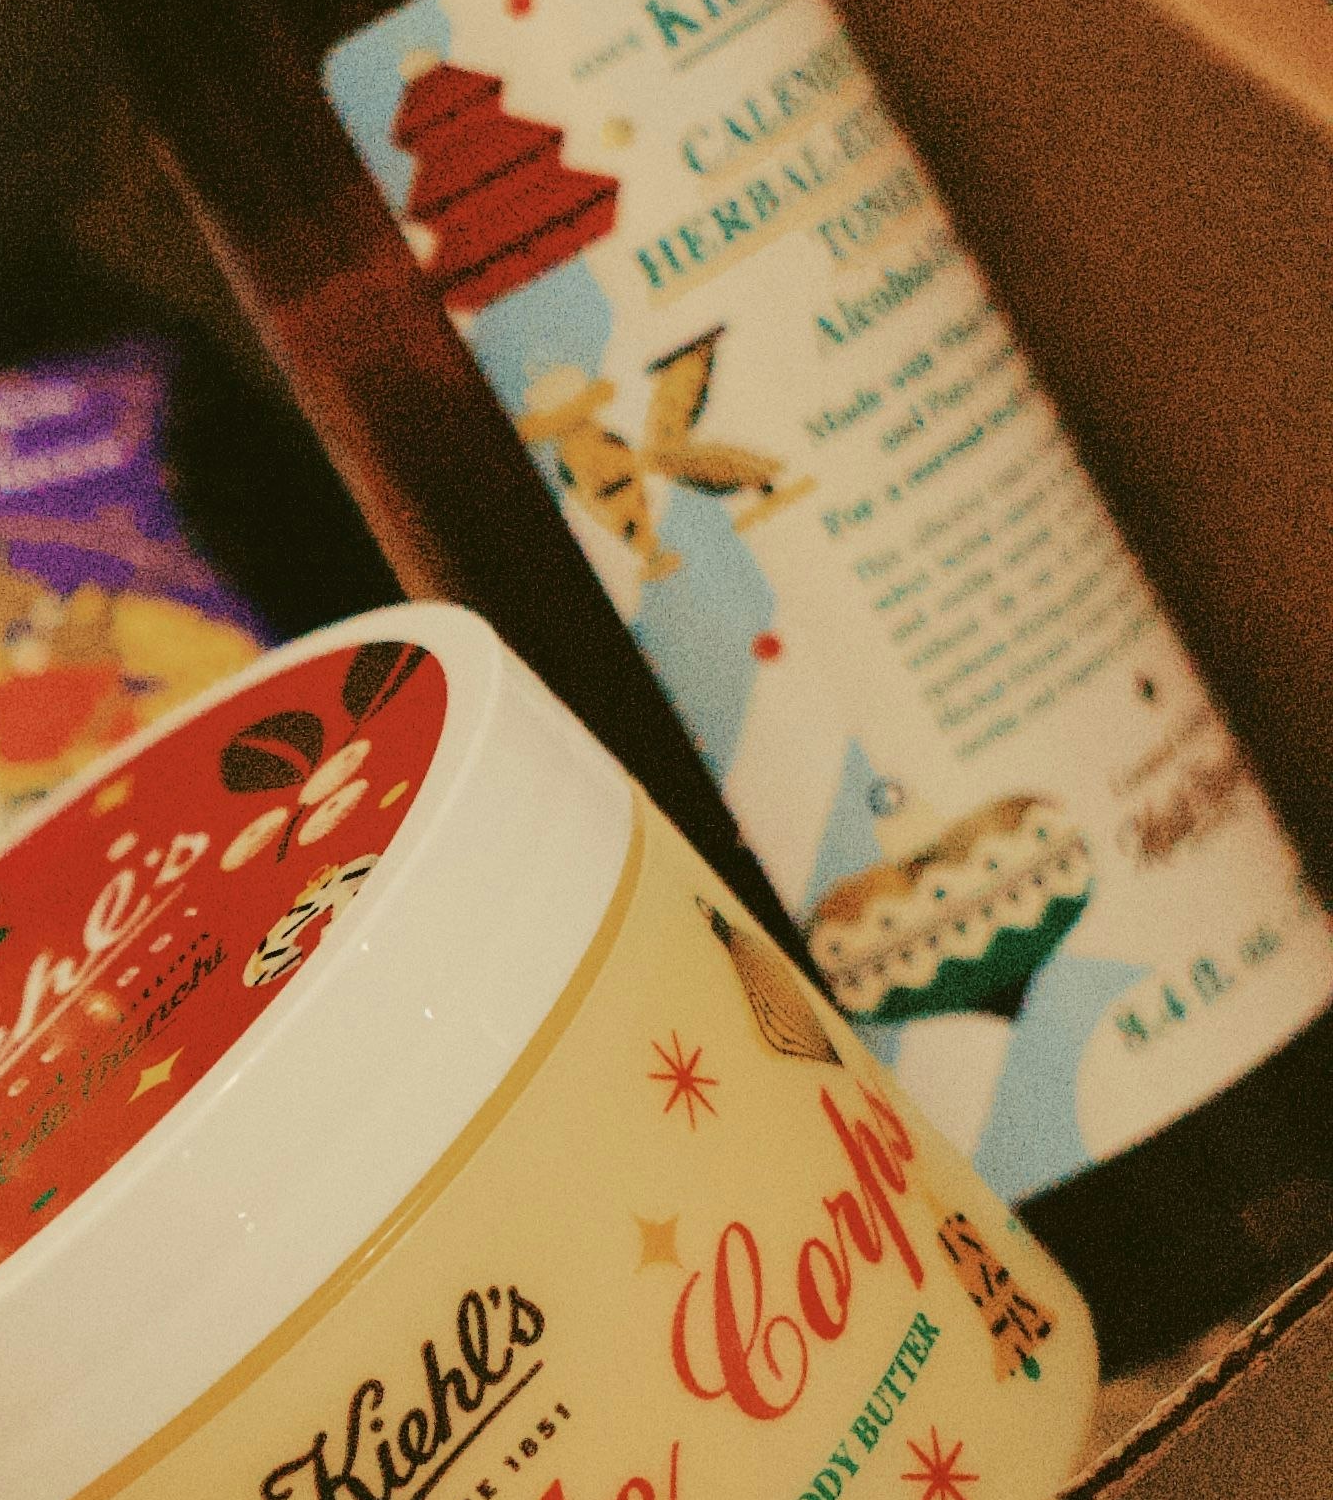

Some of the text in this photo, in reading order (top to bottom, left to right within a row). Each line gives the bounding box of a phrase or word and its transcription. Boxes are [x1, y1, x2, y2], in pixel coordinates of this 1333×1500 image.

[669, 1078, 926, 1422] Corps
[503, 1401, 573, 1473] 1851
[848, 1311, 941, 1455] BUTTER
